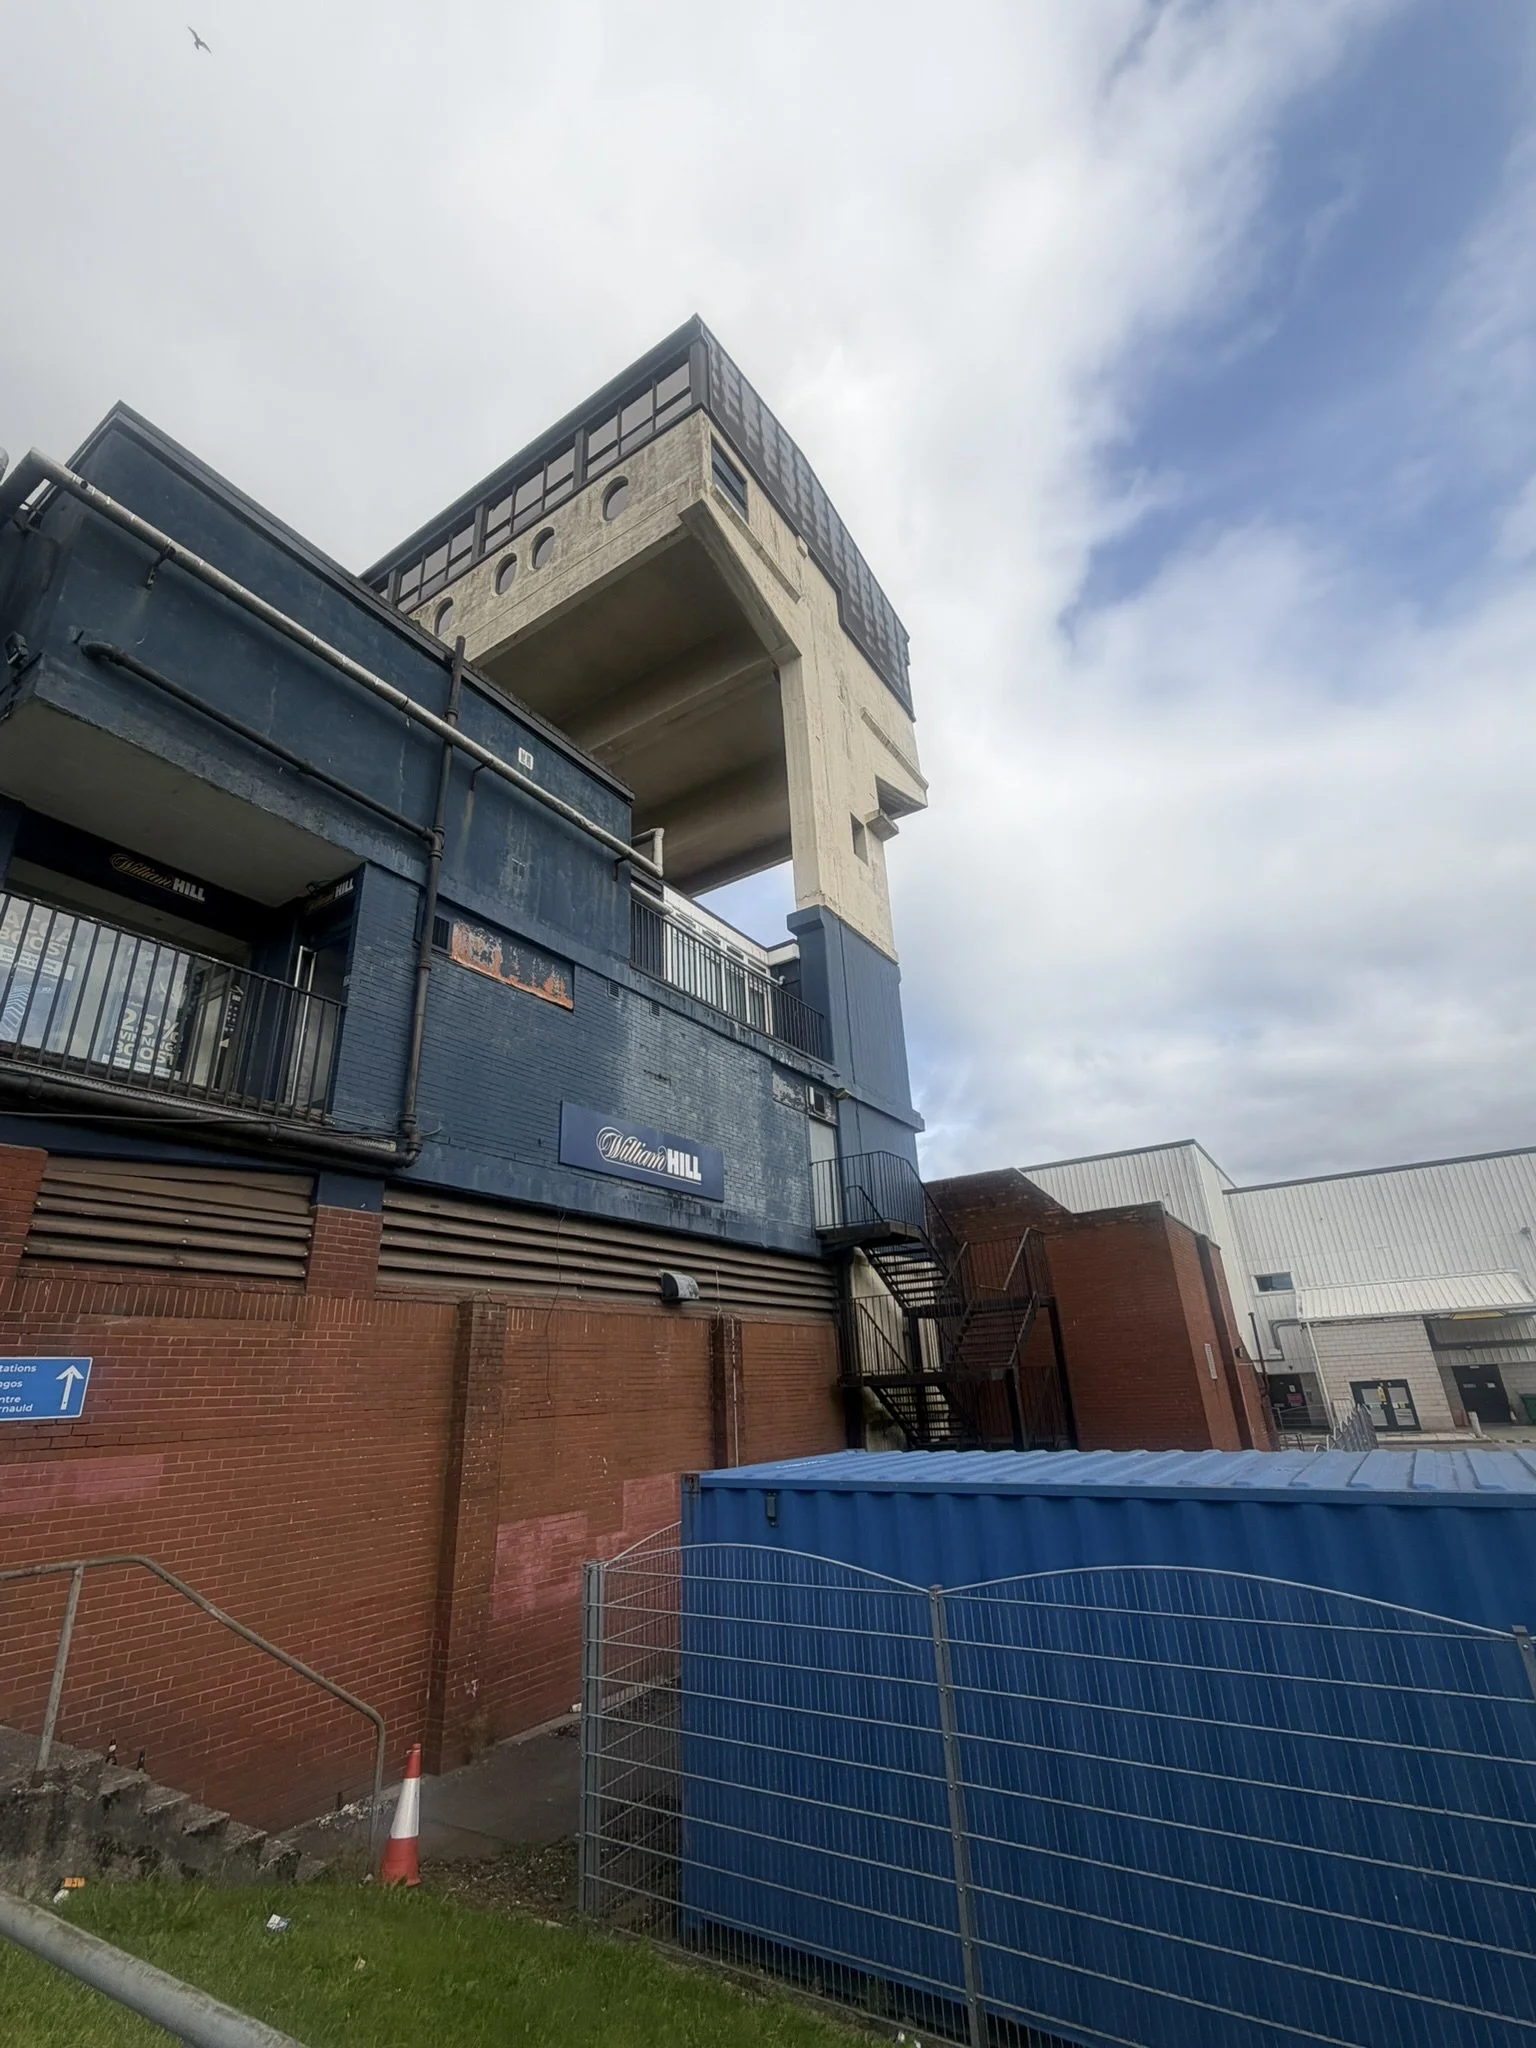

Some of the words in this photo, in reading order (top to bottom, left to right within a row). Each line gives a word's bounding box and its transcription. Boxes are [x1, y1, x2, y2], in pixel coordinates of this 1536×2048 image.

[109, 853, 174, 888] William
[172, 877, 205, 902] HILL
[335, 876, 354, 898] HILL
[120, 1007, 184, 1043] 25%
[596, 1126, 667, 1173] William
[666, 1148, 703, 1182] HILL
